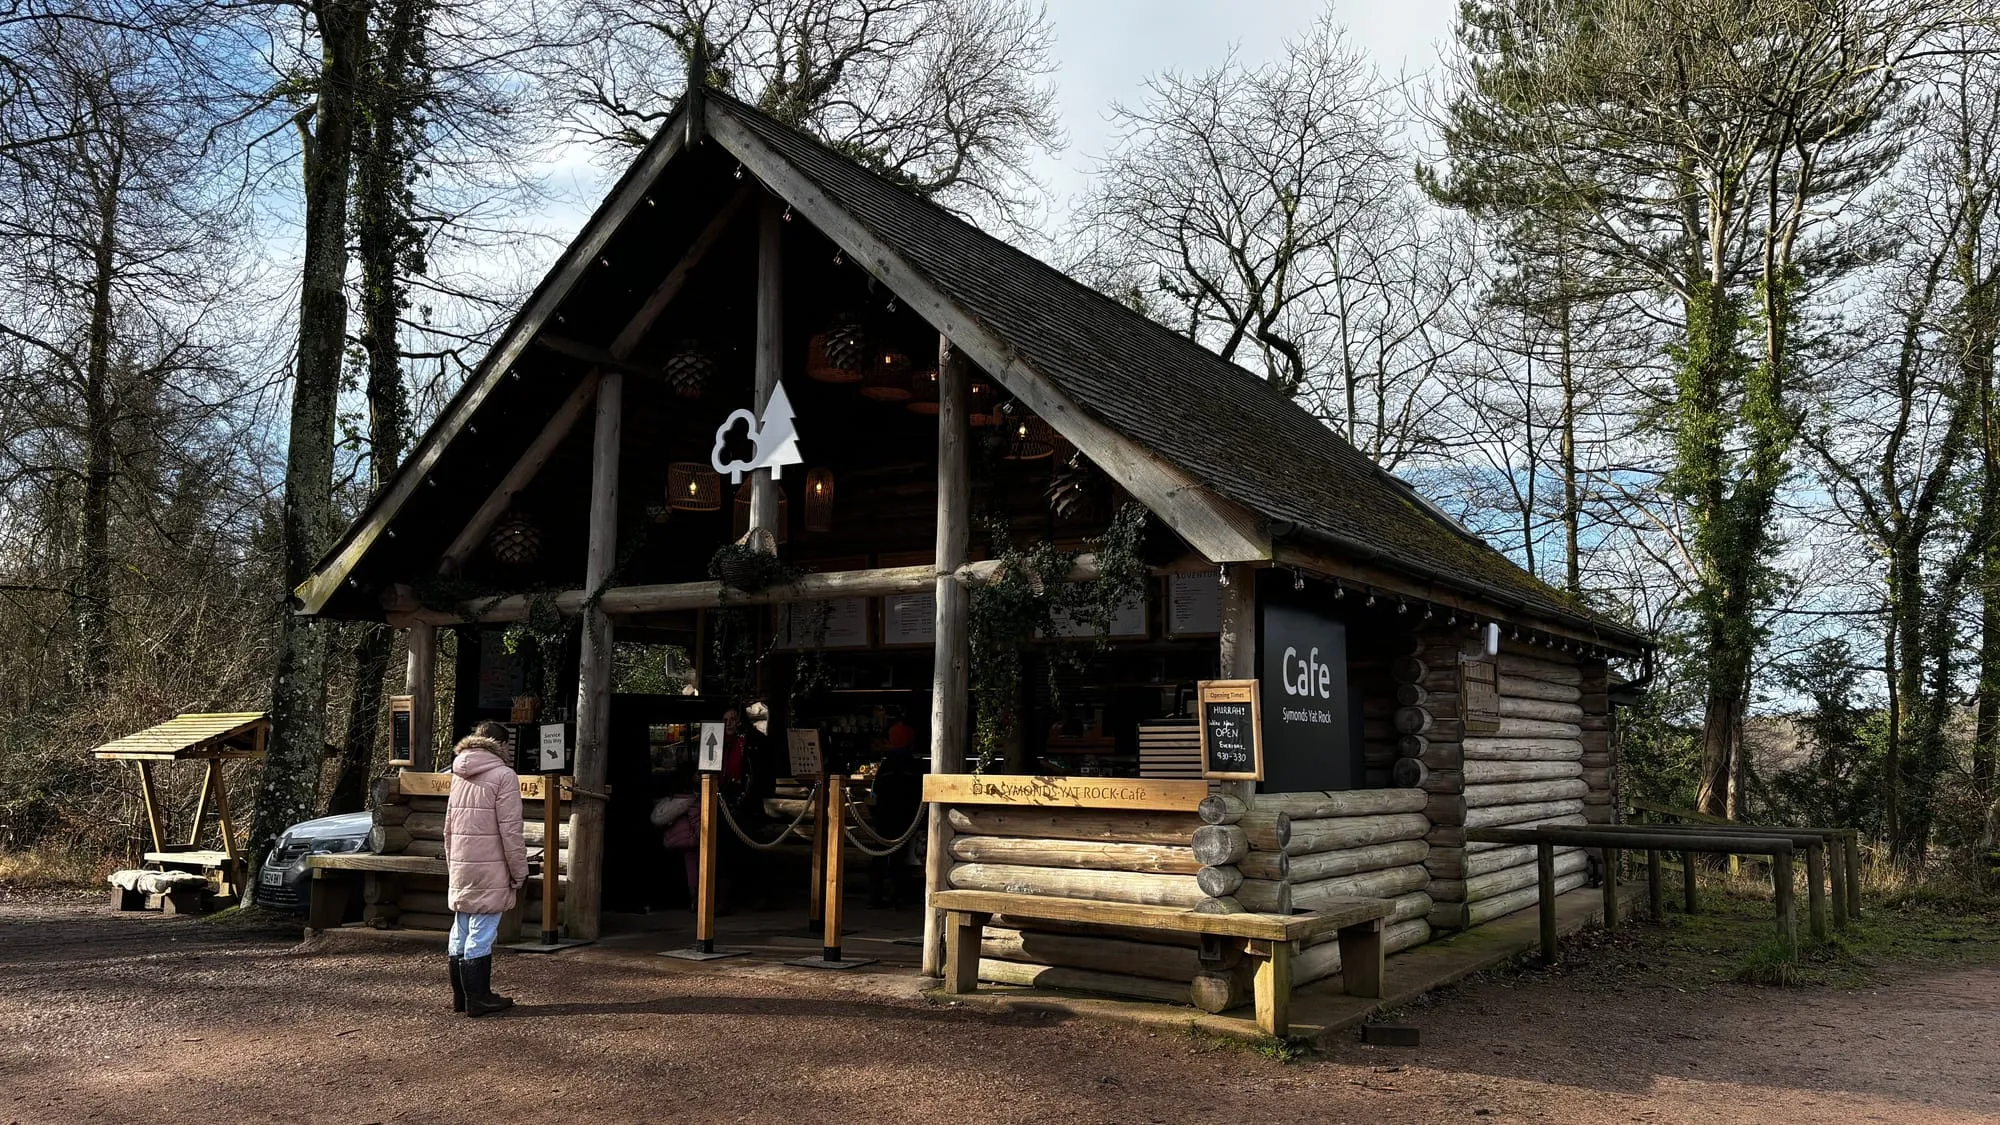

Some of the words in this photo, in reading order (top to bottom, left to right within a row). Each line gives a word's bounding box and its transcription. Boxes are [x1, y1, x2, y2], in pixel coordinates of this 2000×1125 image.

[1282, 646, 1331, 699] Cafe
[1213, 706, 1245, 715] HURRAH!
[1282, 707, 1308, 723] Symonds
[1308, 709, 1318, 722] Yat
[1318, 710, 1332, 724] Rock
[1215, 728, 1239, 738] OPEN
[1083, 787, 1118, 800] ROCK
[1119, 787, 1147, 801] Café
